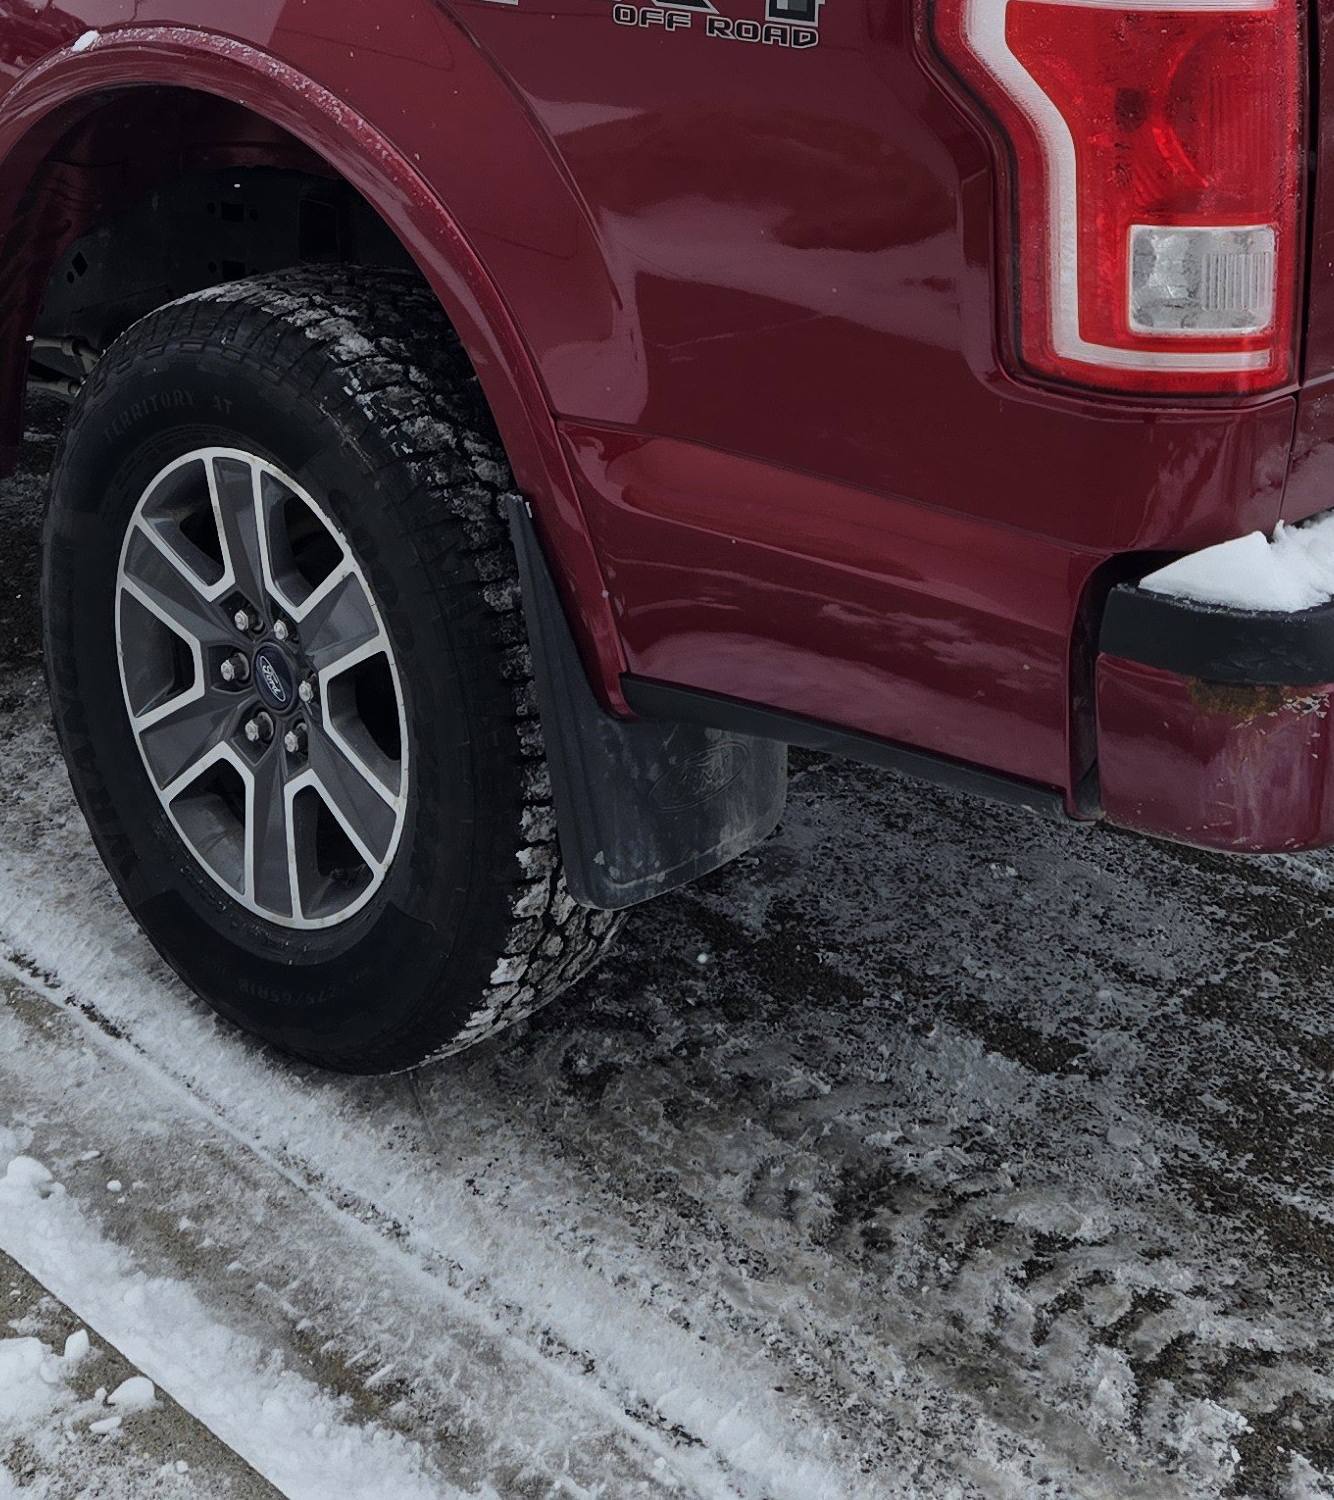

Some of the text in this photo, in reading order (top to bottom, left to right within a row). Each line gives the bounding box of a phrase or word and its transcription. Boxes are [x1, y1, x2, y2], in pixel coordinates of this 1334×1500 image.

[612, 4, 820, 49] OFF ROAD
[101, 388, 234, 443] TERRITORY AT
